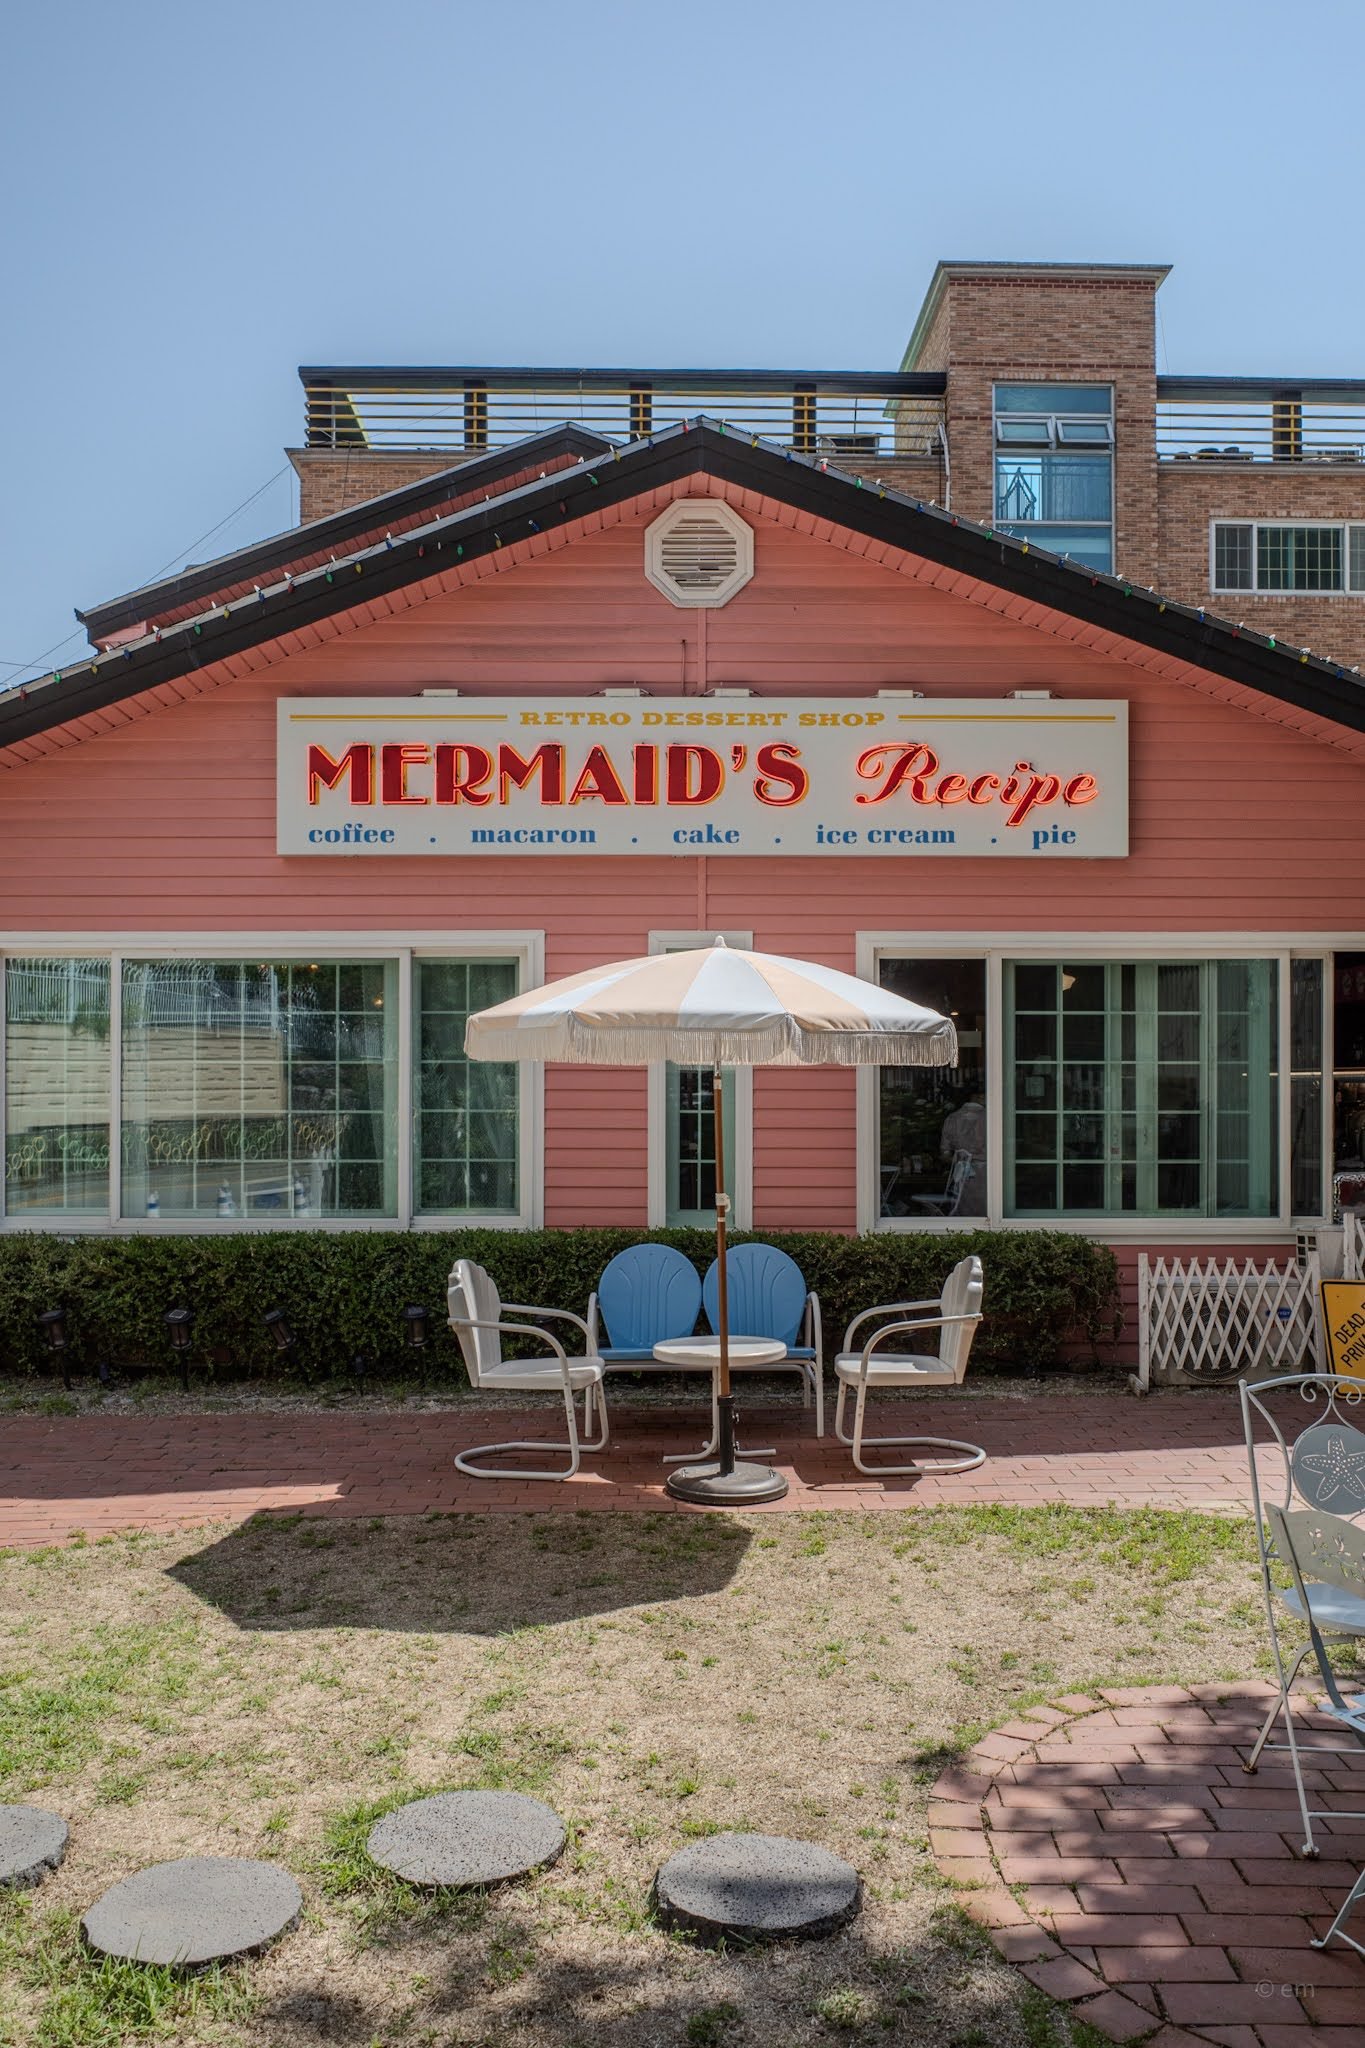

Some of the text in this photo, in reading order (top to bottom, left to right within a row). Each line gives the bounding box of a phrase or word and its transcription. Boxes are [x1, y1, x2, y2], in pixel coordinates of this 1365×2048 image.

[520, 711, 886, 728] RETRO DESSERT SHOP
[306, 741, 1100, 828] MERMAID'S Recipe
[308, 823, 1077, 850] coffee macaron cake ice cream pie
[1334, 1312, 1365, 1345] DEAD
